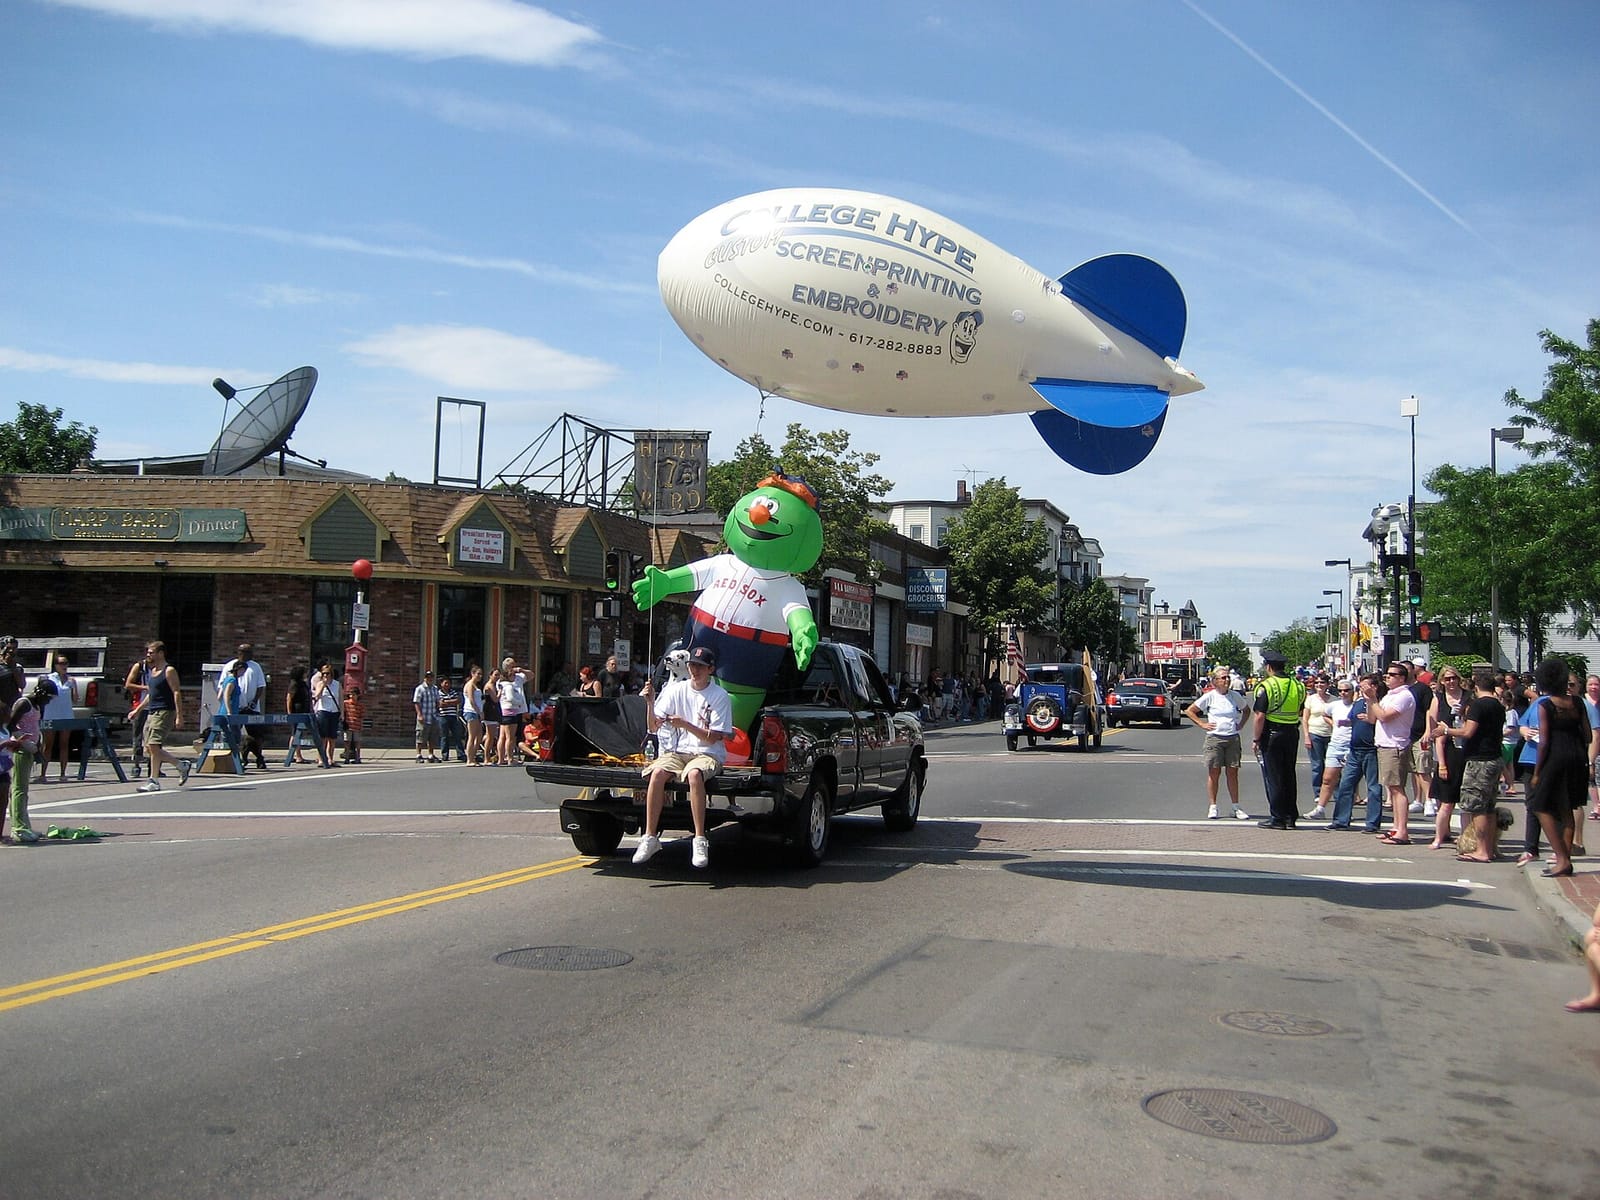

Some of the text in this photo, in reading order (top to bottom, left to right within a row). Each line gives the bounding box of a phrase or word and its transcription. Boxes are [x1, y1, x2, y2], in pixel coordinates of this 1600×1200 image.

[721, 204, 977, 274] CLLEGE HYPE
[867, 283, 881, 299] &
[714, 273, 833, 336] COLLEGEHYPE.COM
[792, 284, 948, 337] EMBROIDERY
[122, 512, 173, 528] BARD
[189, 518, 239, 535] Dinner
[713, 578, 768, 608] RED SOX
[909, 585, 944, 593] DISCOUNT
[907, 594, 945, 603] GROCERIES
